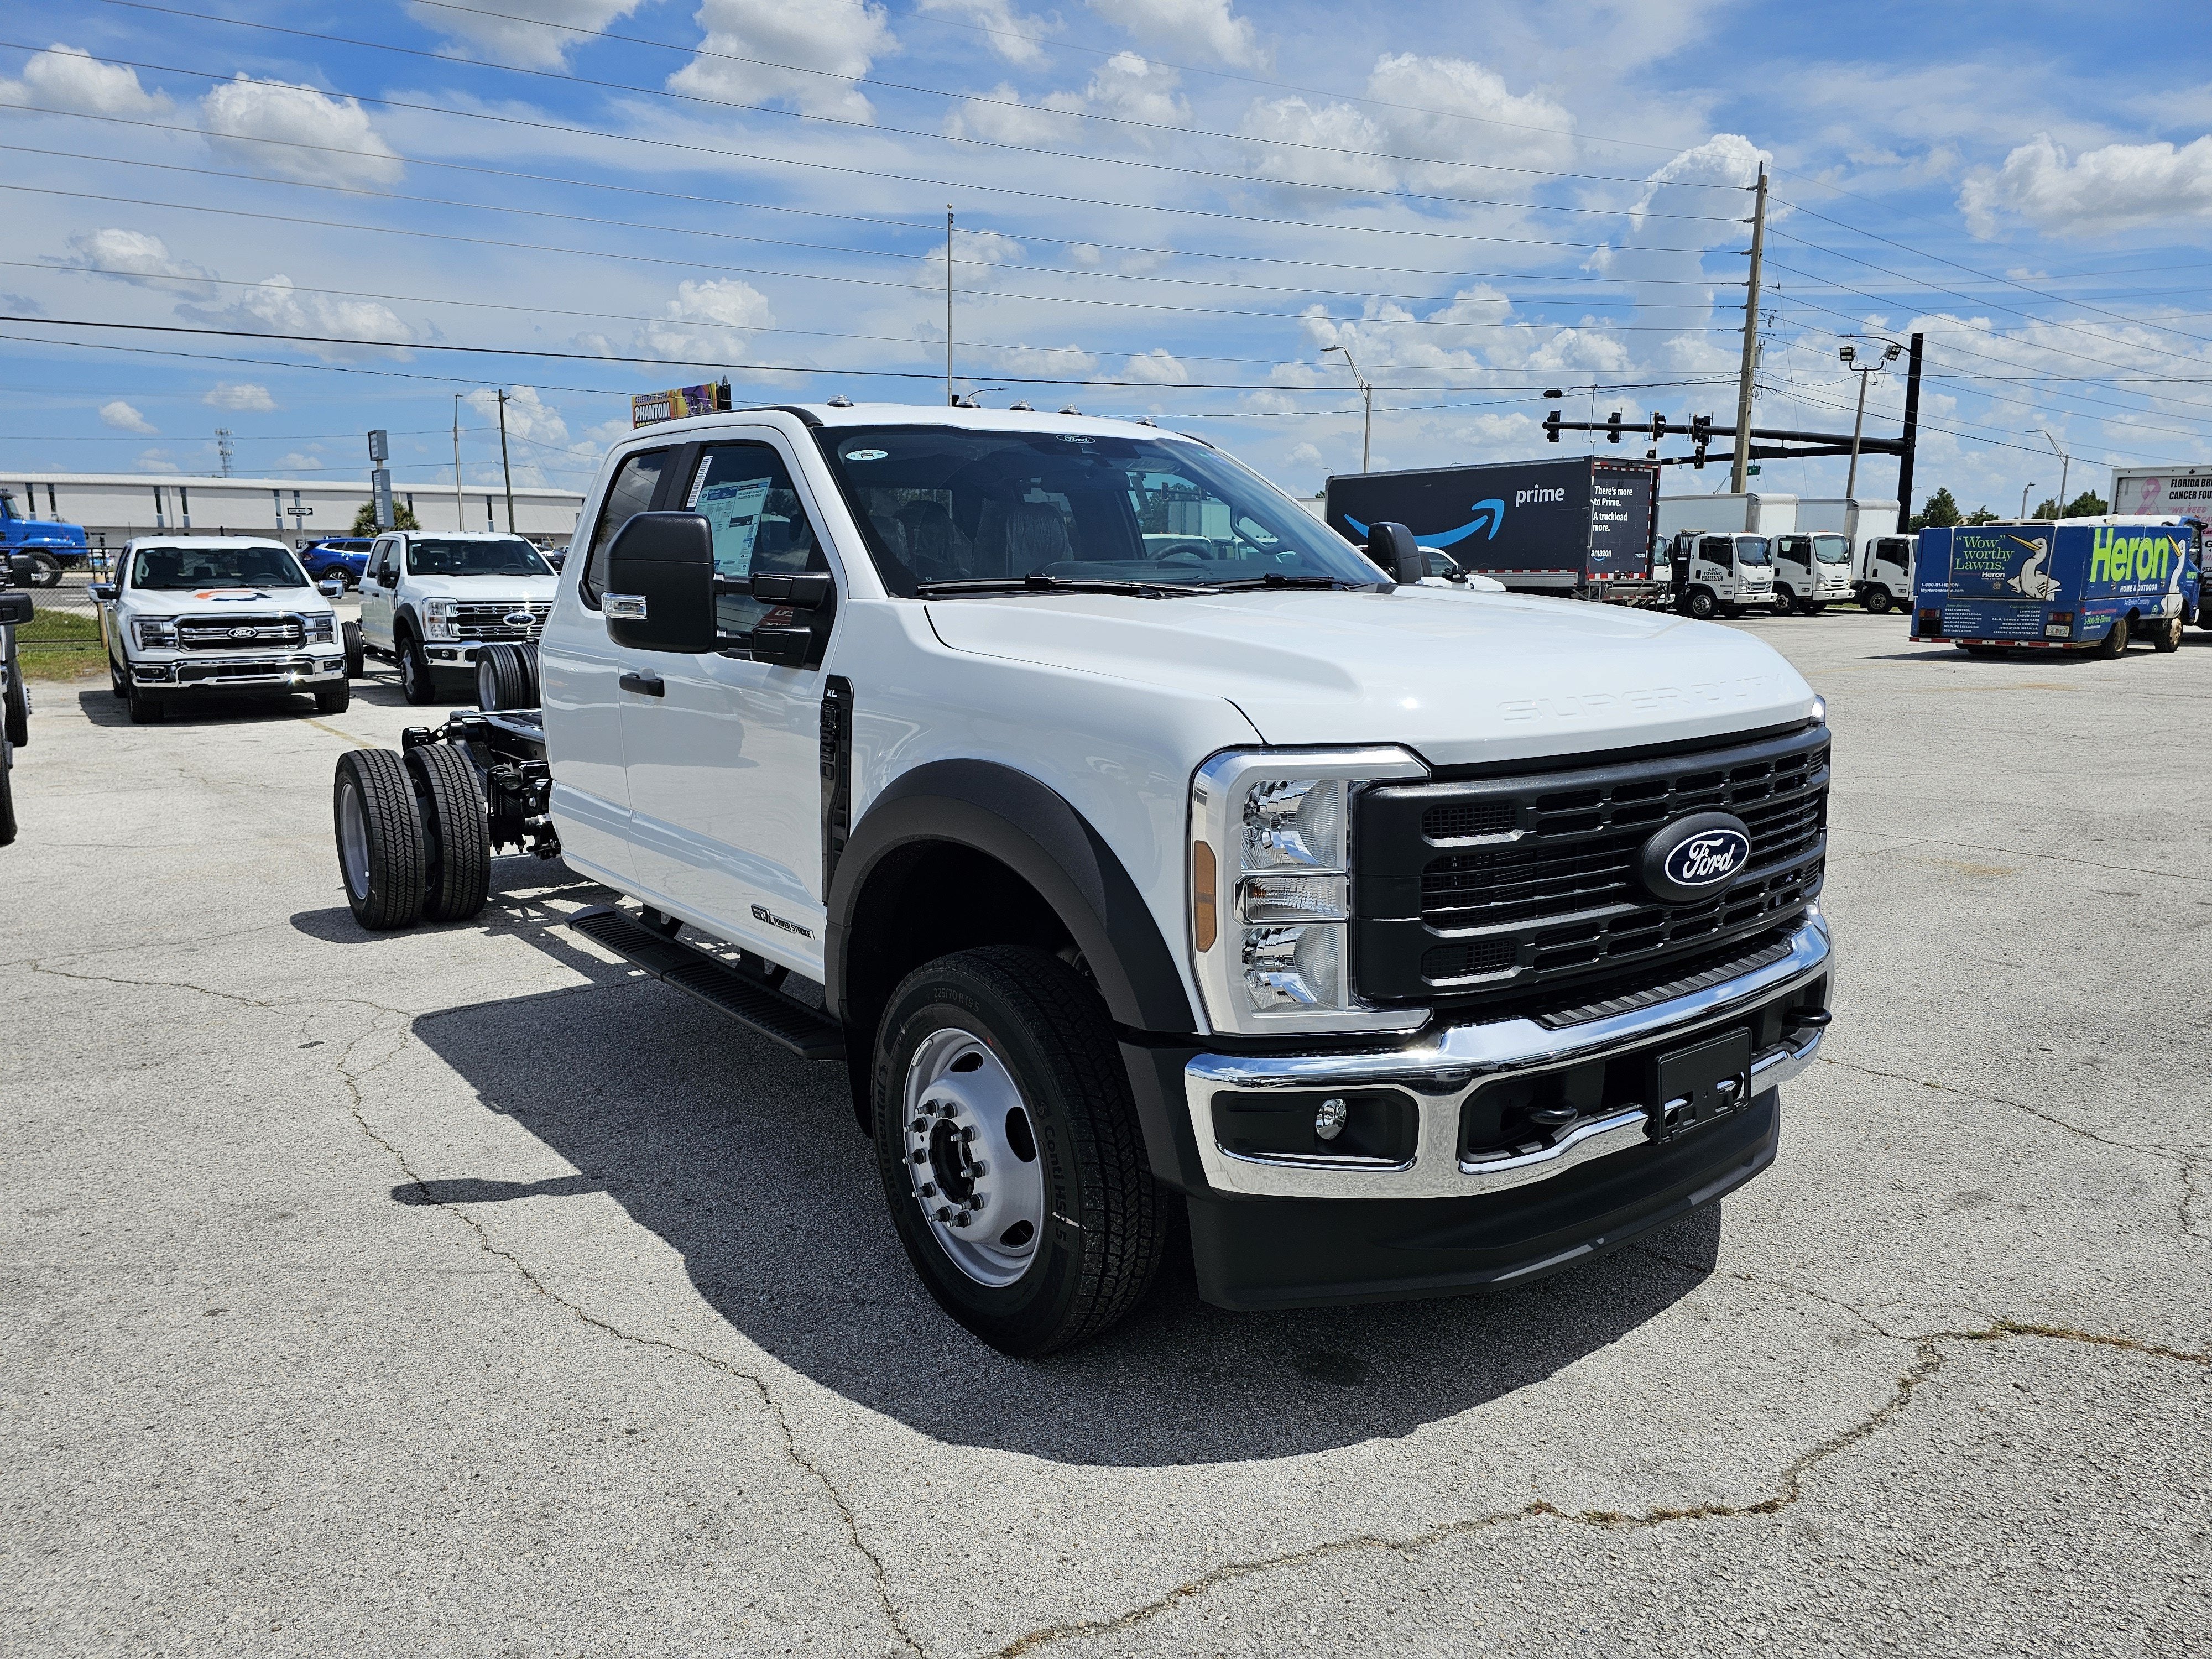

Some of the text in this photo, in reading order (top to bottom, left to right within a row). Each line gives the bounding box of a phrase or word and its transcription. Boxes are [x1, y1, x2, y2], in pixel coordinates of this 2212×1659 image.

[635, 401, 670, 422] PHANTOM
[2171, 479, 2199, 487] FLORIDA
[1516, 484, 1564, 507] prime
[1594, 486, 1633, 496] There's more
[2169, 491, 2198, 499] CANCER
[1601, 497, 1621, 507] Prime.
[1593, 512, 1627, 521] A truckload
[1593, 524, 1610, 532] more.
[1590, 549, 1612, 557] amazon
[1963, 547, 2015, 562] worthy
[2089, 527, 2169, 583] Heron
[1954, 557, 2005, 571] Lawns.
[2120, 585, 2133, 593] HOME
[2137, 583, 2158, 592] OUTDOOR
[826, 689, 837, 698] XL
[1496, 674, 1780, 721] SUPER DUTY
[1683, 838, 1736, 879] Ford
[750, 903, 775, 926] 6.7L
[774, 917, 791, 931] POWER
[791, 924, 812, 939] STROKE
[933, 987, 980, 1013] 225/70 R 19.5
[1044, 1125, 1065, 1180] Conti
[1055, 1228, 1067, 1241] 5
